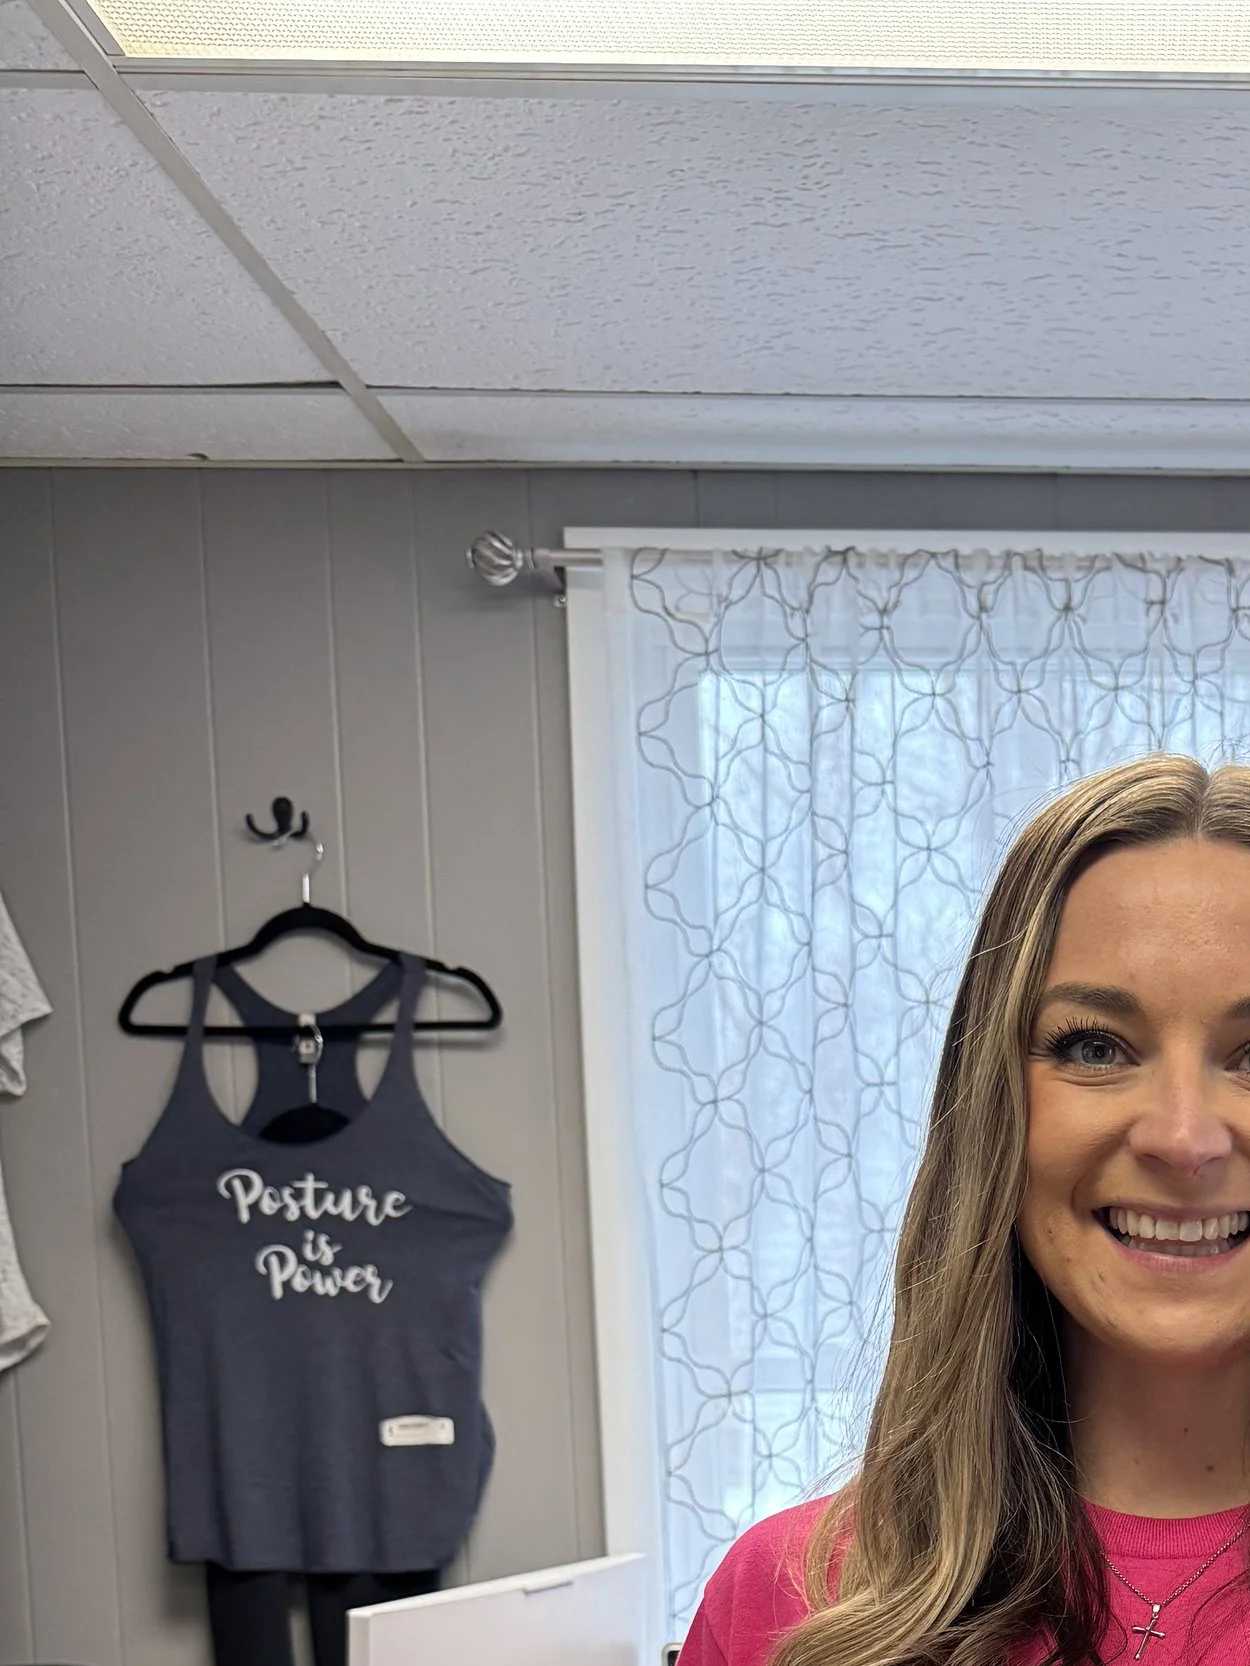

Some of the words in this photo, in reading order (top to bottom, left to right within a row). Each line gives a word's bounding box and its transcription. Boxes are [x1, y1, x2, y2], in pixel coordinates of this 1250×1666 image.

[217, 1168, 413, 1226] Posture
[255, 1244, 393, 1304] Power
[302, 1229, 342, 1265] is
